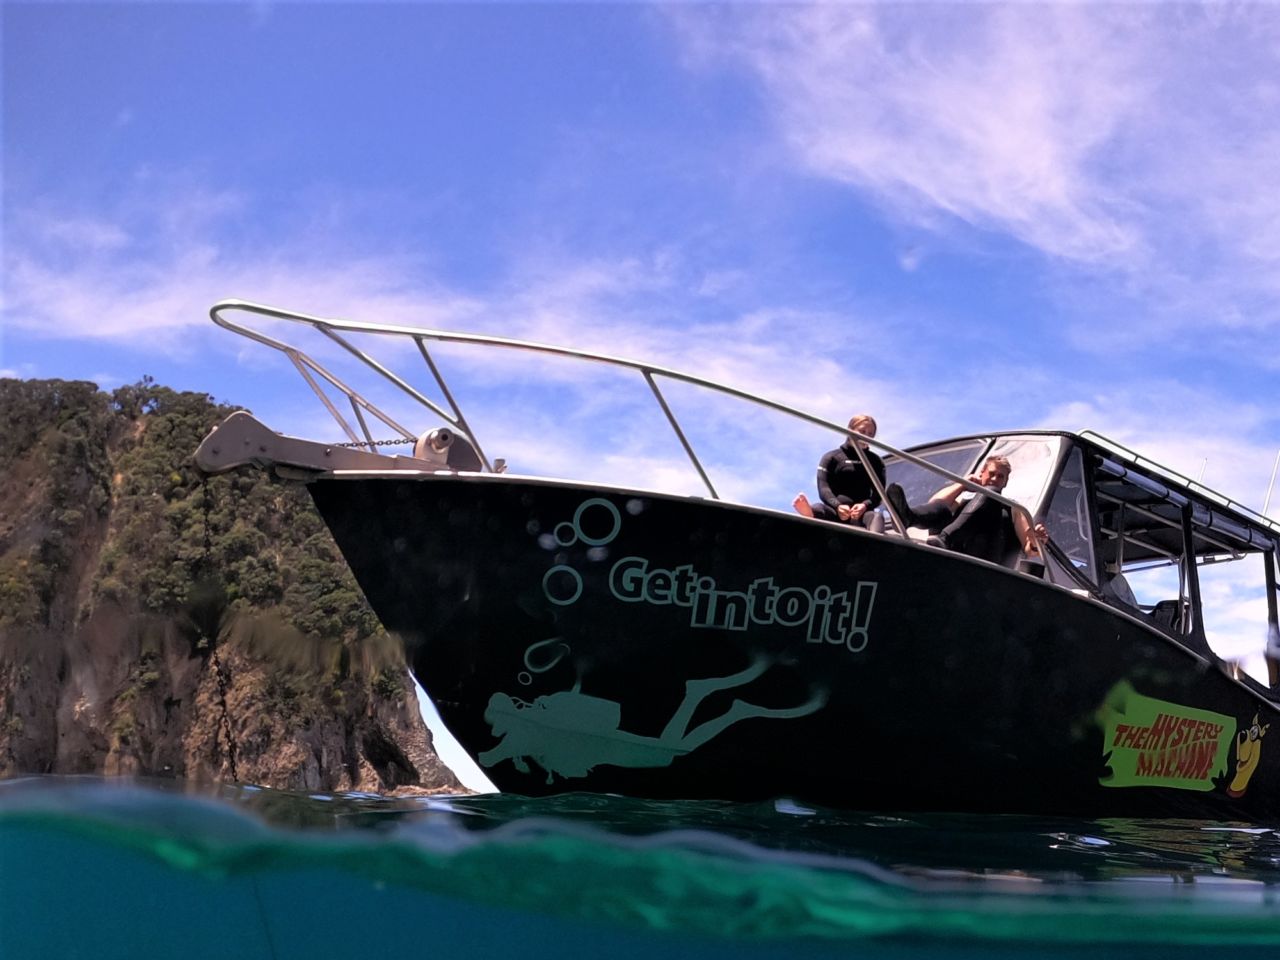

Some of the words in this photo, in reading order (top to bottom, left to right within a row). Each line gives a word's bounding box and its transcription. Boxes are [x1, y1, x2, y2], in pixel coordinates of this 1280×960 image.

[1112, 723, 1150, 750] THE
[1141, 713, 1225, 751] MYSTERY
[1136, 740, 1219, 780] MACHINE
